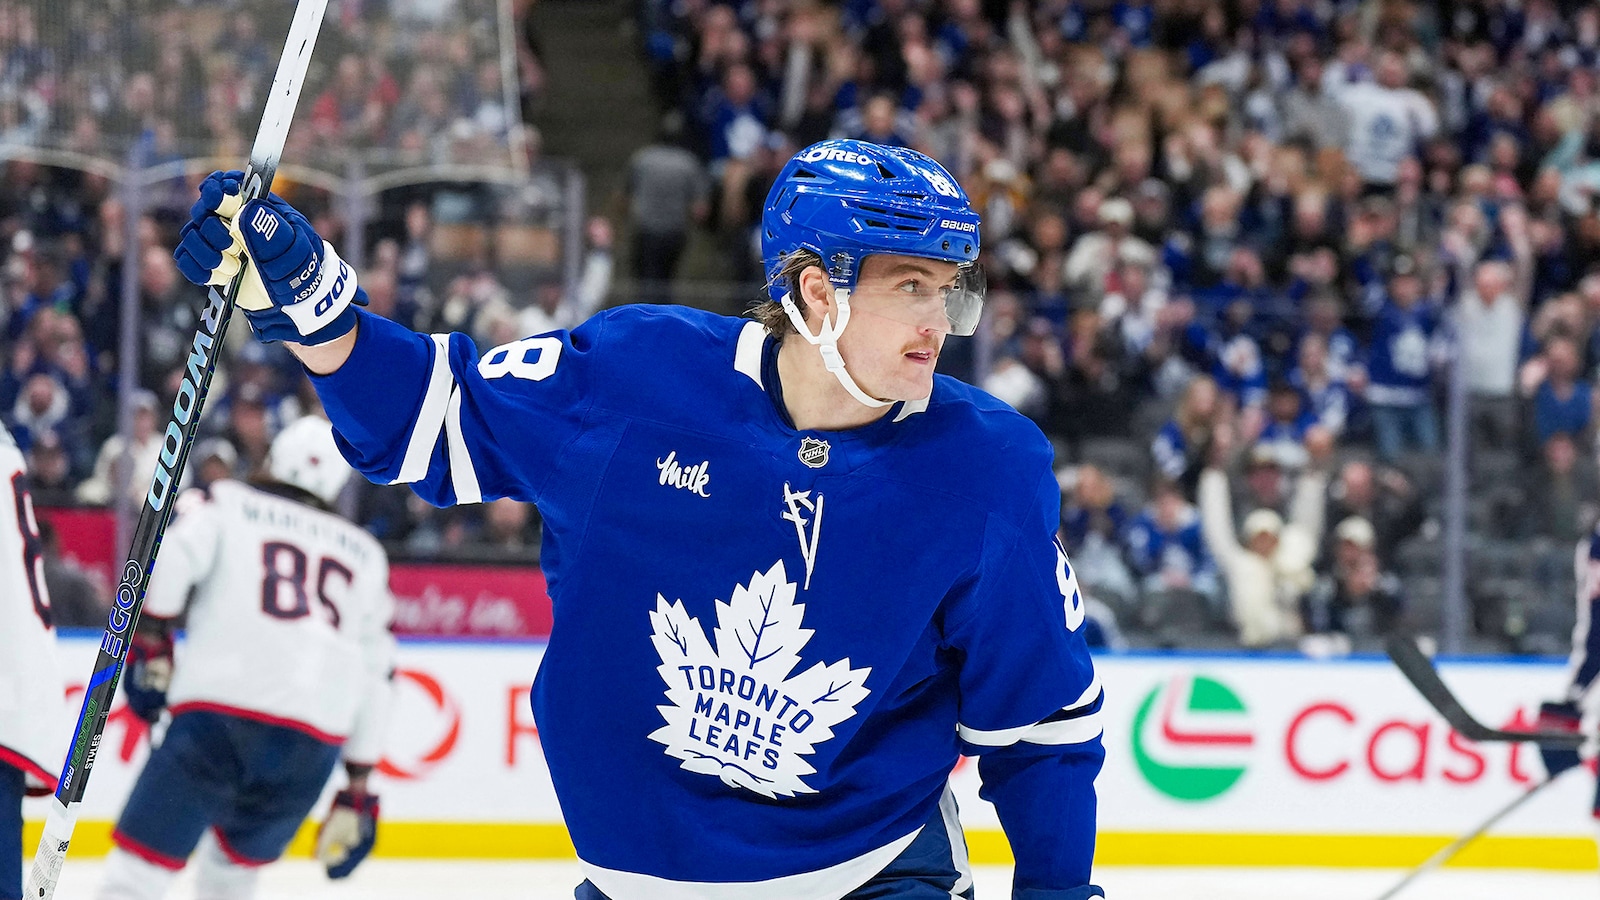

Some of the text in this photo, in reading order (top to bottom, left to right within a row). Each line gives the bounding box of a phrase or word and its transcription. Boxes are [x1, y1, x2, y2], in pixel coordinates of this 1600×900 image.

[804, 147, 869, 165] OREO
[940, 219, 976, 233] BAUER
[656, 451, 712, 497] Milk
[804, 448, 825, 459] NHL
[1053, 535, 1085, 632] 8
[100, 559, 143, 659] CODE
[678, 665, 814, 734] TORONTO
[694, 692, 786, 747] MAPLE
[84, 734, 101, 770] STYLES
[689, 717, 779, 770] LEAFS
[64, 765, 75, 790] PRO
